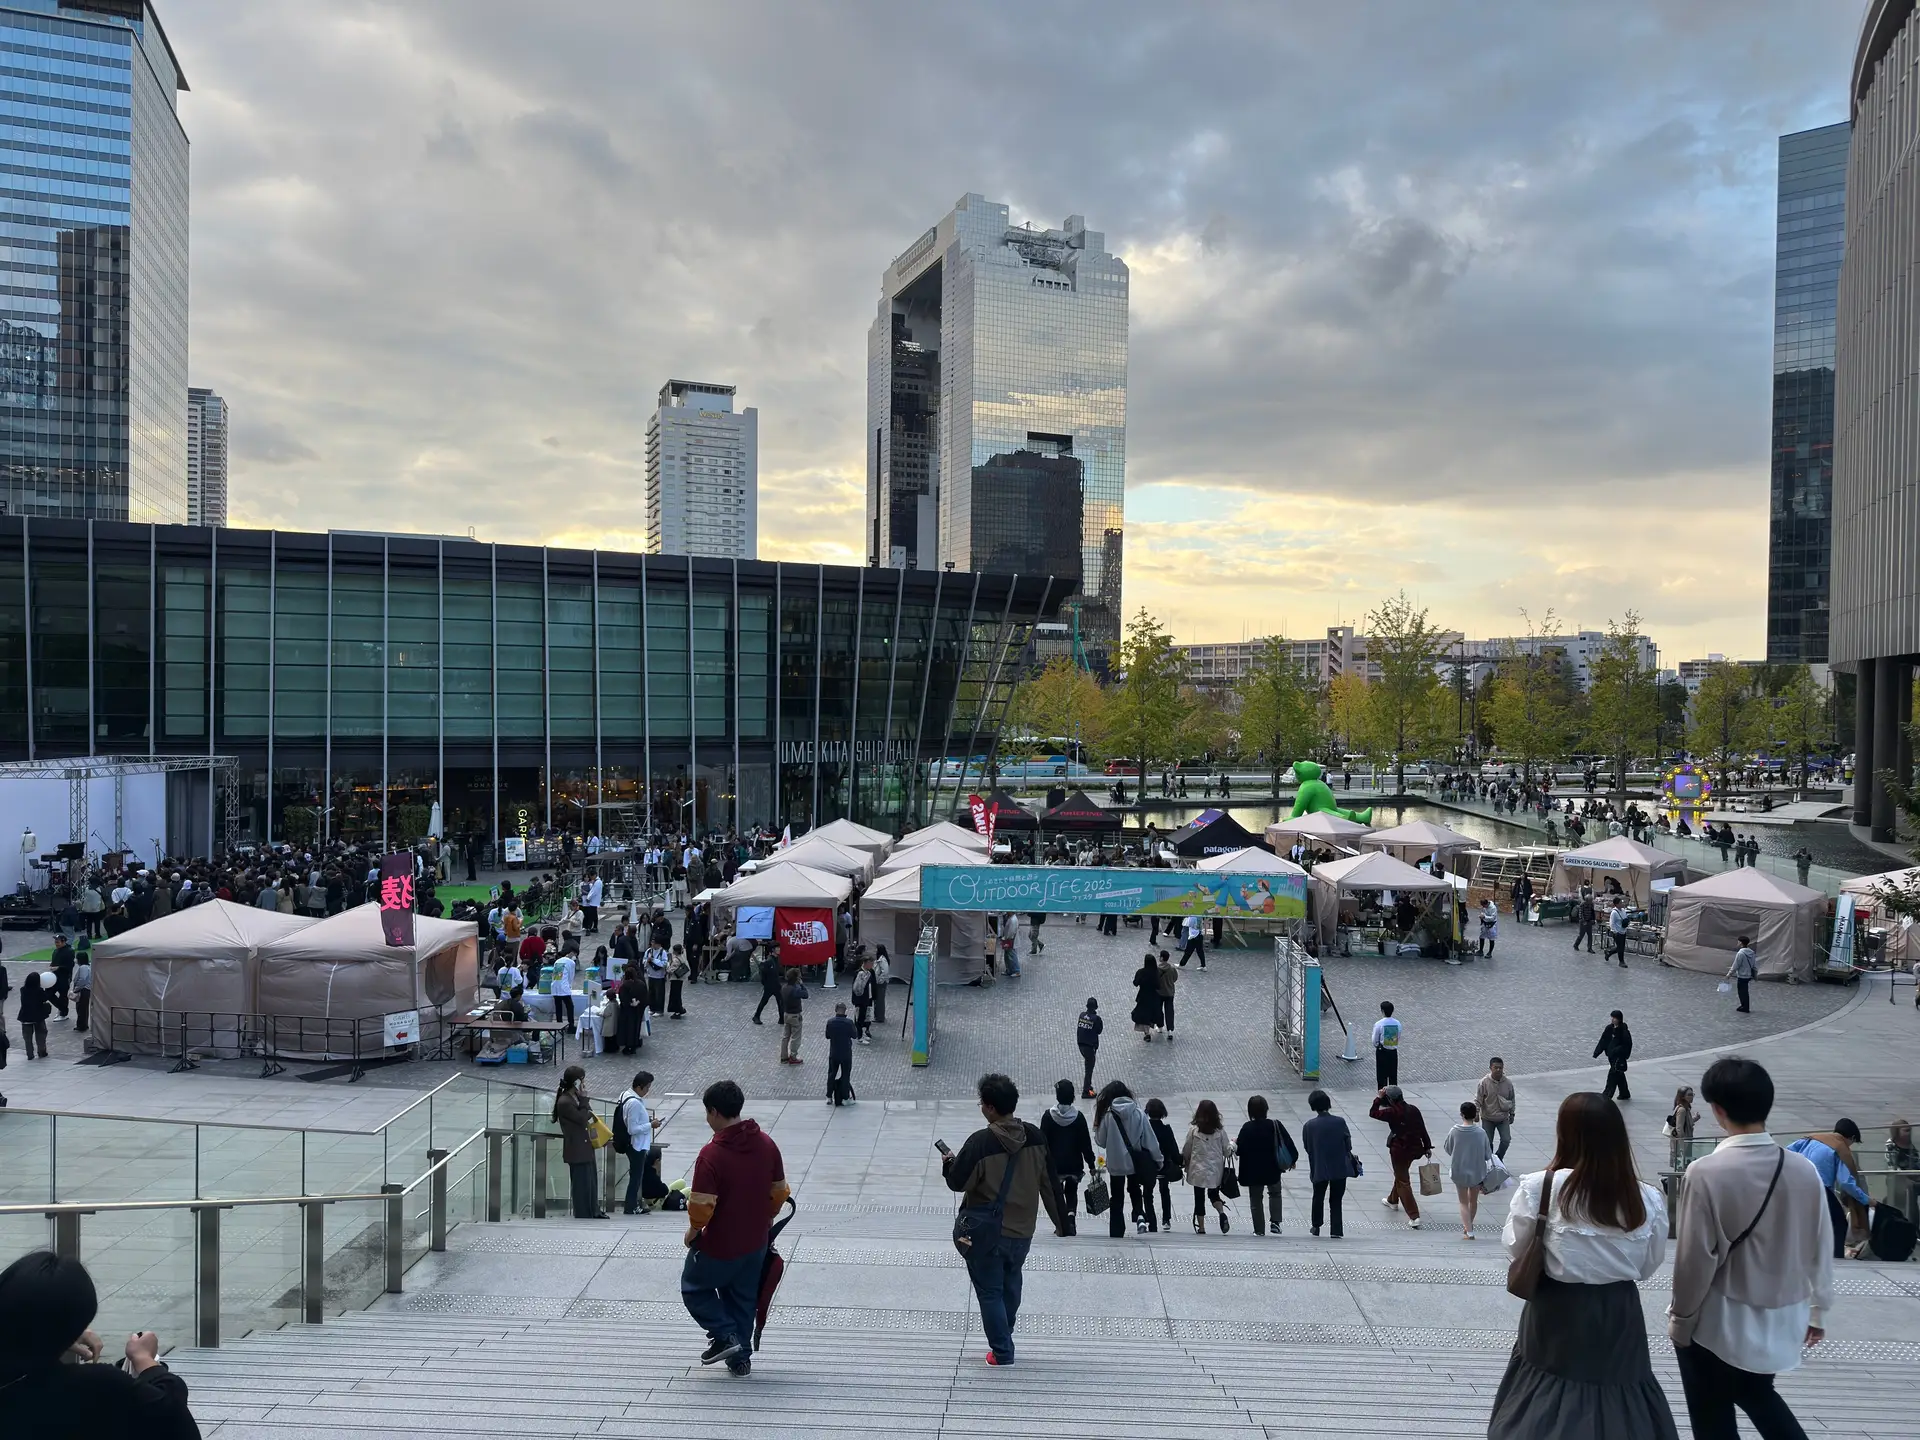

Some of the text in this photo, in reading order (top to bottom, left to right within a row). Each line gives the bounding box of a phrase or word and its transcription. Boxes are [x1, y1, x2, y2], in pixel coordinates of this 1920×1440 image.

[856, 740, 883, 762] SHIP
[889, 739, 914, 761] HALL
[1037, 873, 1082, 907] LIFE
[1084, 878, 1113, 892] 2025
[793, 921, 812, 930] THE
[781, 929, 812, 938] NORTH
[1834, 916, 1846, 947] MAMMUT
[789, 937, 813, 945] FACE
[1078, 1022, 1093, 1030] CREW
